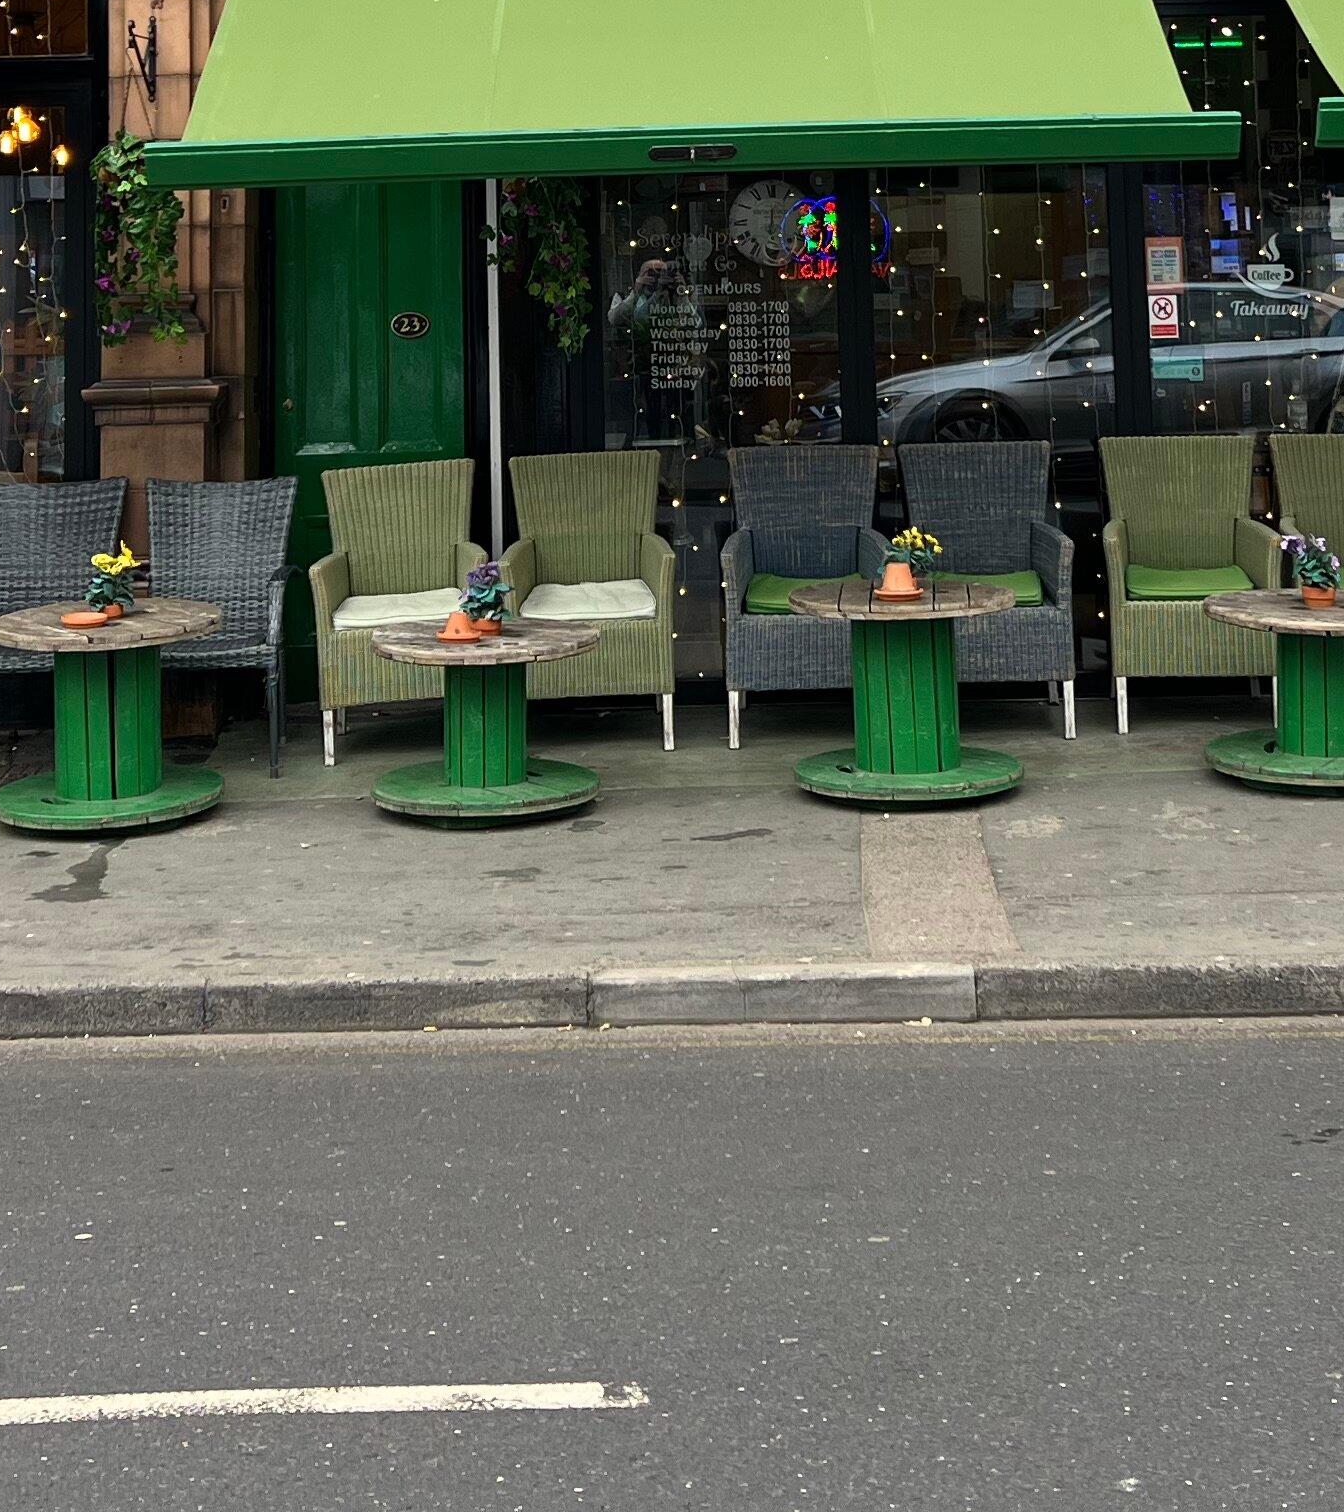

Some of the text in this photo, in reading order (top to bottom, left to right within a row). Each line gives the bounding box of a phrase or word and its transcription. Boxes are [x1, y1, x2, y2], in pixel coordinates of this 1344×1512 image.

[1251, 270, 1282, 281] Coffee
[677, 283, 762, 295] OPEN HOURS
[649, 301, 789, 315] Monday 0830-1700
[1230, 300, 1309, 320] Takeaway
[400, 317, 420, 332] 23
[650, 314, 790, 328] Tuesday 0830-1700
[650, 326, 790, 341] Wednesday 0830-1700
[650, 338, 791, 353] Thursday 0830-1700
[650, 354, 690, 366] Friday
[650, 363, 791, 378] Saturday 0830-1700
[650, 376, 792, 391] Sunday 0900-1600
